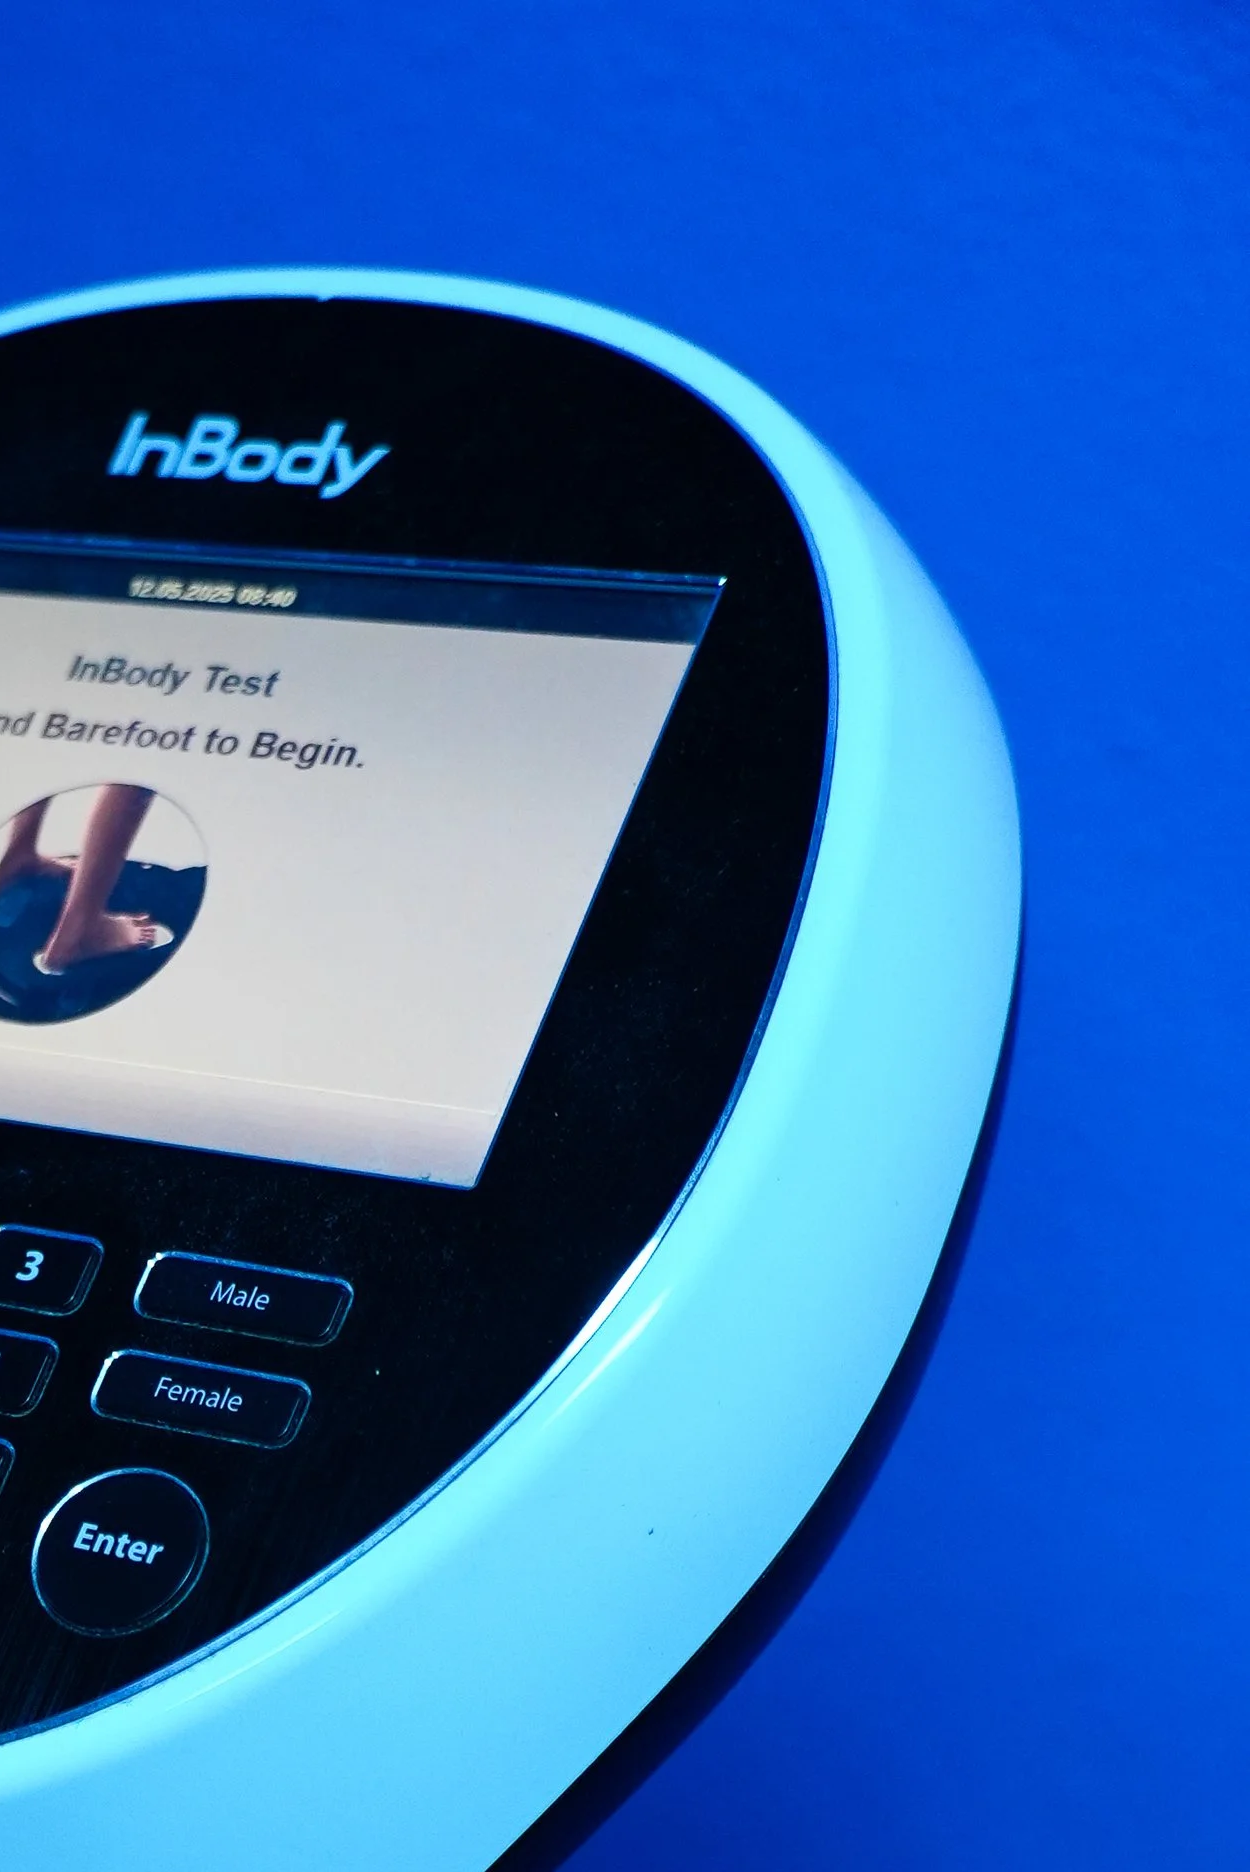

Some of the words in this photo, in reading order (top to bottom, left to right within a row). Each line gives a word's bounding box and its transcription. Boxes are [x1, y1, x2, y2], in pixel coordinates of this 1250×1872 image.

[108, 410, 391, 499] InBody
[66, 654, 190, 696] InBody
[204, 665, 281, 698] Test
[40, 713, 196, 754] Barefoot
[203, 728, 239, 756] to
[250, 732, 365, 770] Begin.
[15, 1250, 45, 1281] 3
[210, 1281, 270, 1311] Male
[154, 1377, 243, 1413] Female
[73, 1522, 164, 1565] Enter
